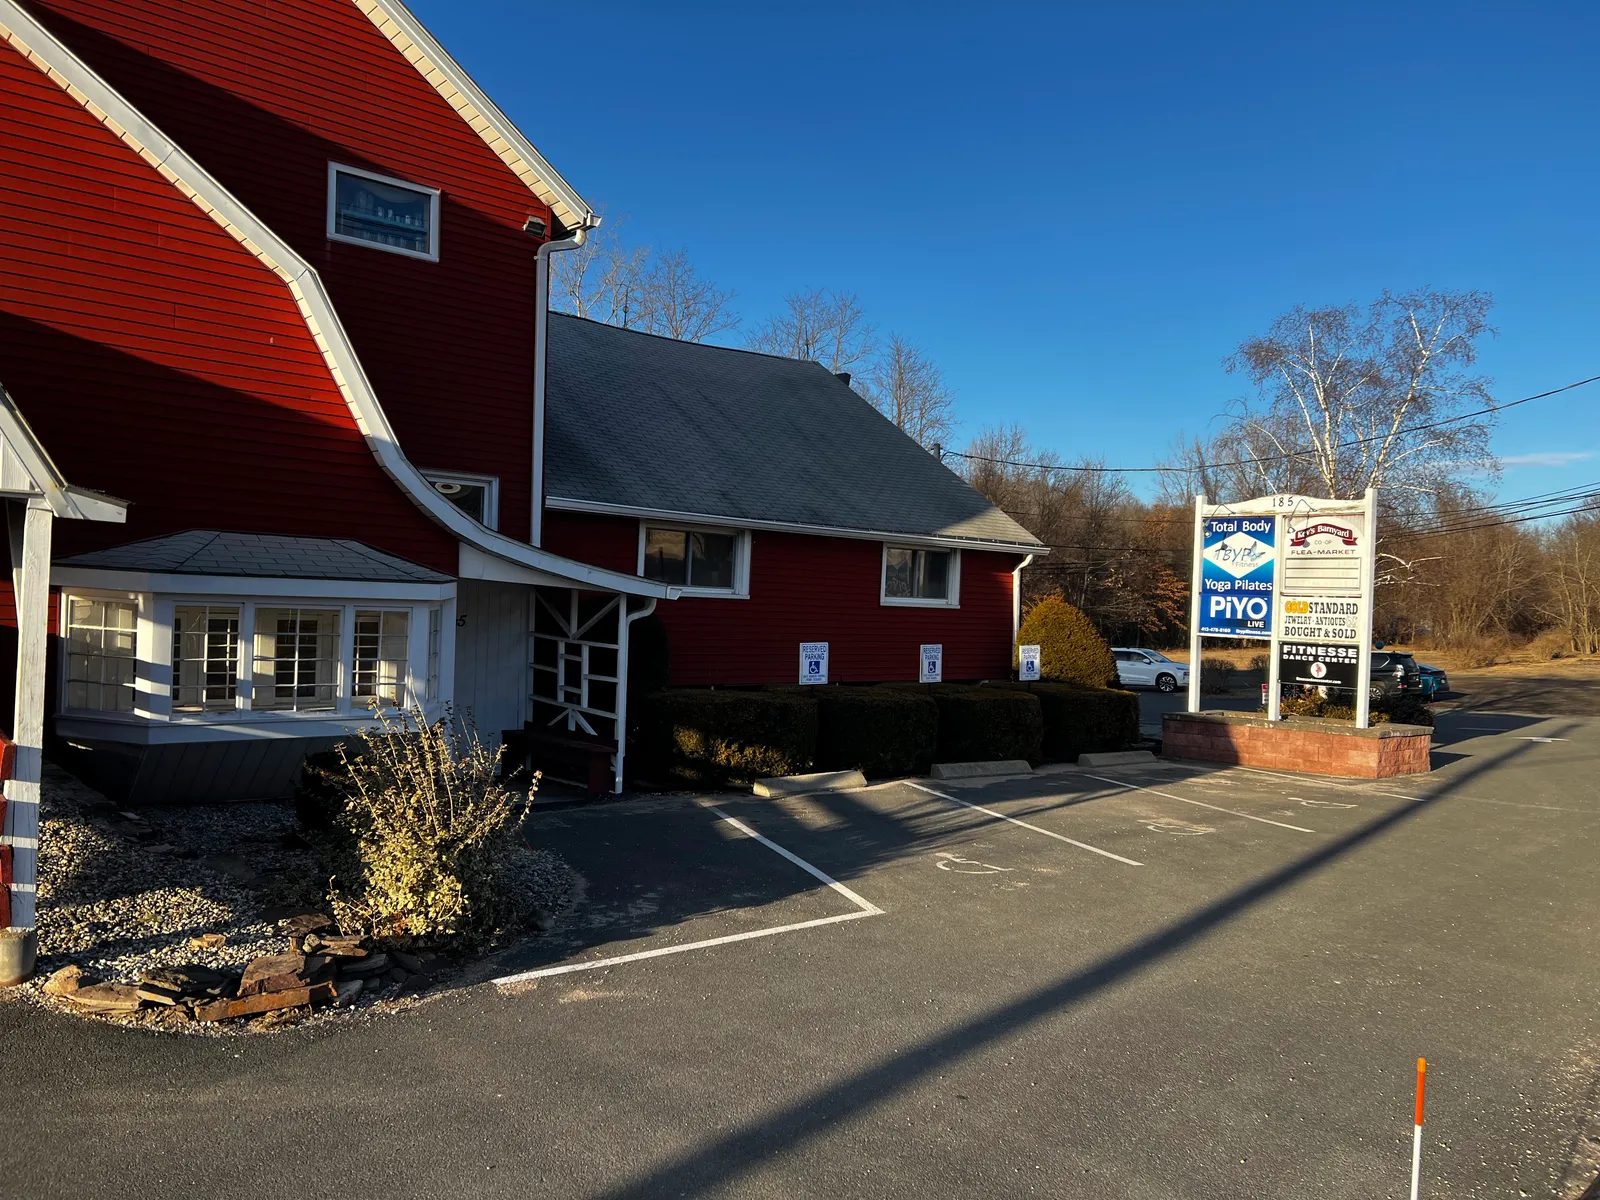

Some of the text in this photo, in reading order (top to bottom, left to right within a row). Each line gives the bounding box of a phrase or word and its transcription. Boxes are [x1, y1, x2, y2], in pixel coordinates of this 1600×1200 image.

[1272, 496, 1294, 507] 185
[1211, 520, 1271, 533] Total Body
[1317, 525, 1349, 537] Barnyard
[1205, 579, 1273, 592] Yoga Pilates
[1210, 596, 1268, 620] PiYO
[1285, 601, 1358, 615] GOLD STANDARD
[1284, 615, 1346, 626] JEWELRY ANTIQUES
[1284, 626, 1357, 639] BOUGHT & SOLD
[803, 645, 827, 653] RESERVED
[1283, 645, 1358, 658] FITNESSE
[804, 653, 825, 661] PARKING
[1282, 654, 1357, 664] DANCE CENTER
